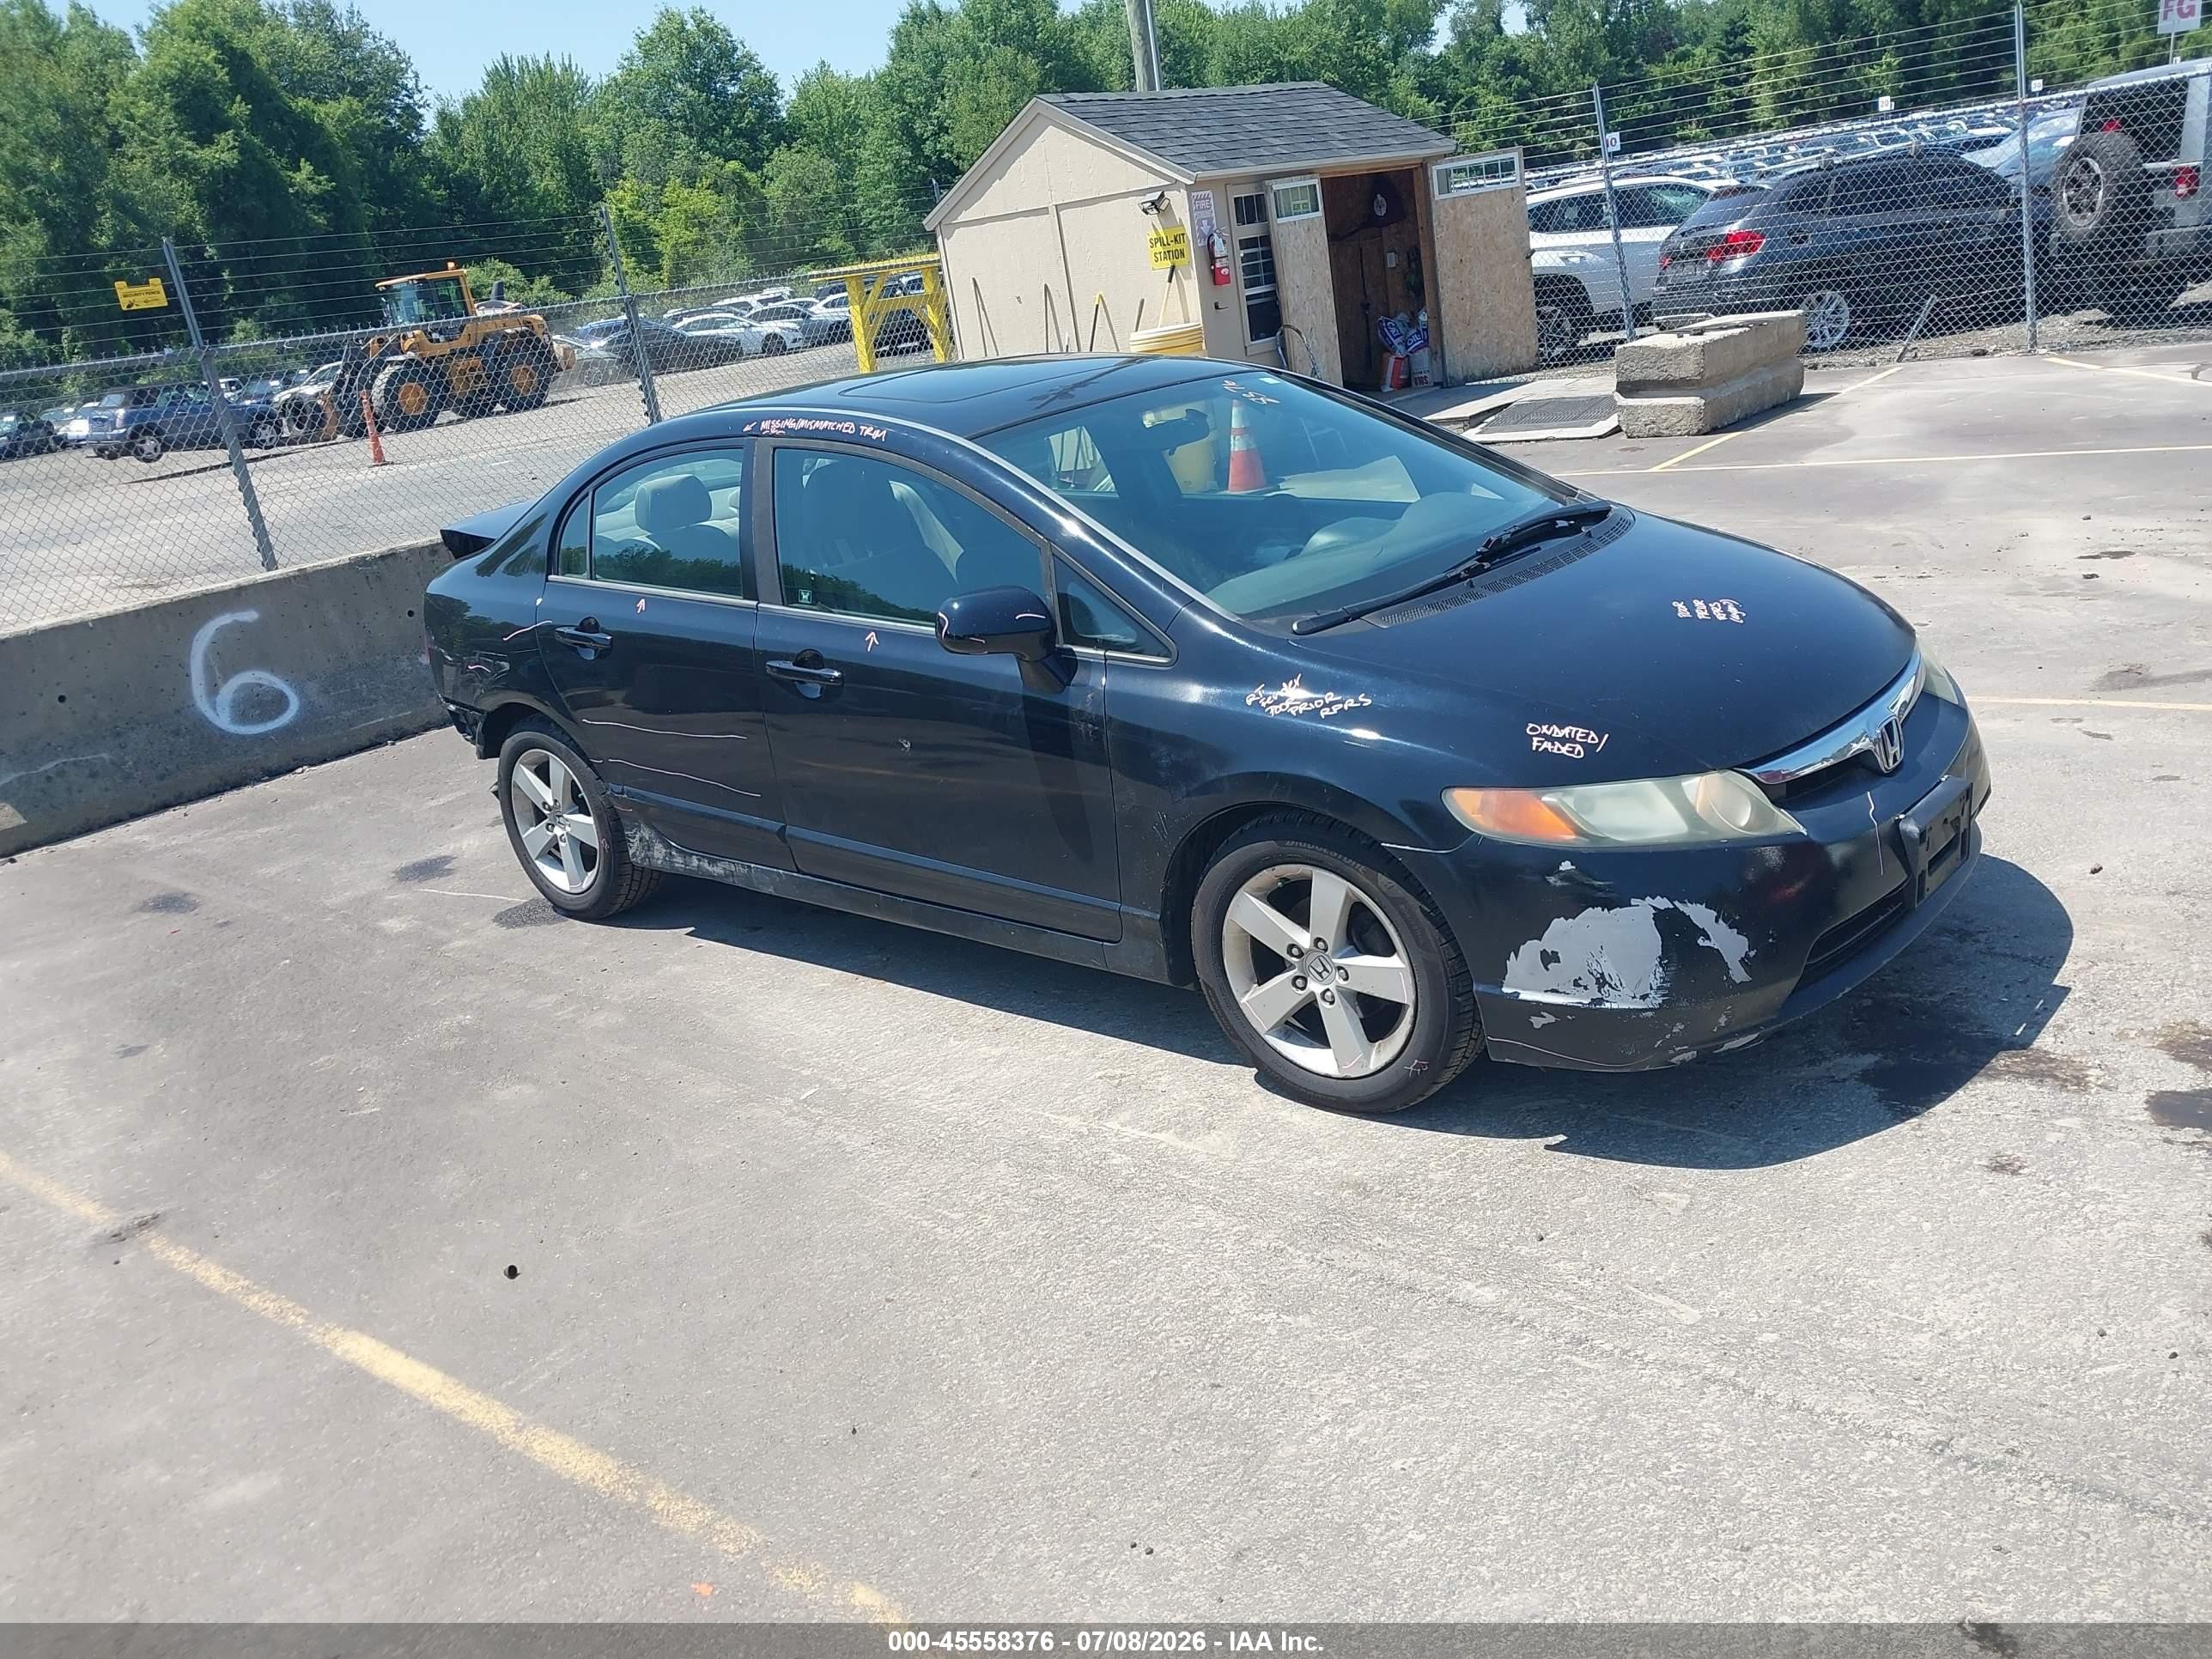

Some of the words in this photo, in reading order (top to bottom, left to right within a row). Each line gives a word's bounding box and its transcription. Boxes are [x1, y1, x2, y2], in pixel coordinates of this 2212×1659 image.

[2162, 0, 2196, 21] FG
[1194, 198, 1210, 210] FIRE
[1149, 233, 1186, 249] SPILL-KIT
[1153, 248, 1186, 263] STATION
[859, 424, 887, 441] TRIM
[190, 611, 301, 735] 6
[1288, 691, 1342, 716] PRIOR
[1319, 693, 1373, 720] RPRS
[1532, 737, 1585, 759] FADED
